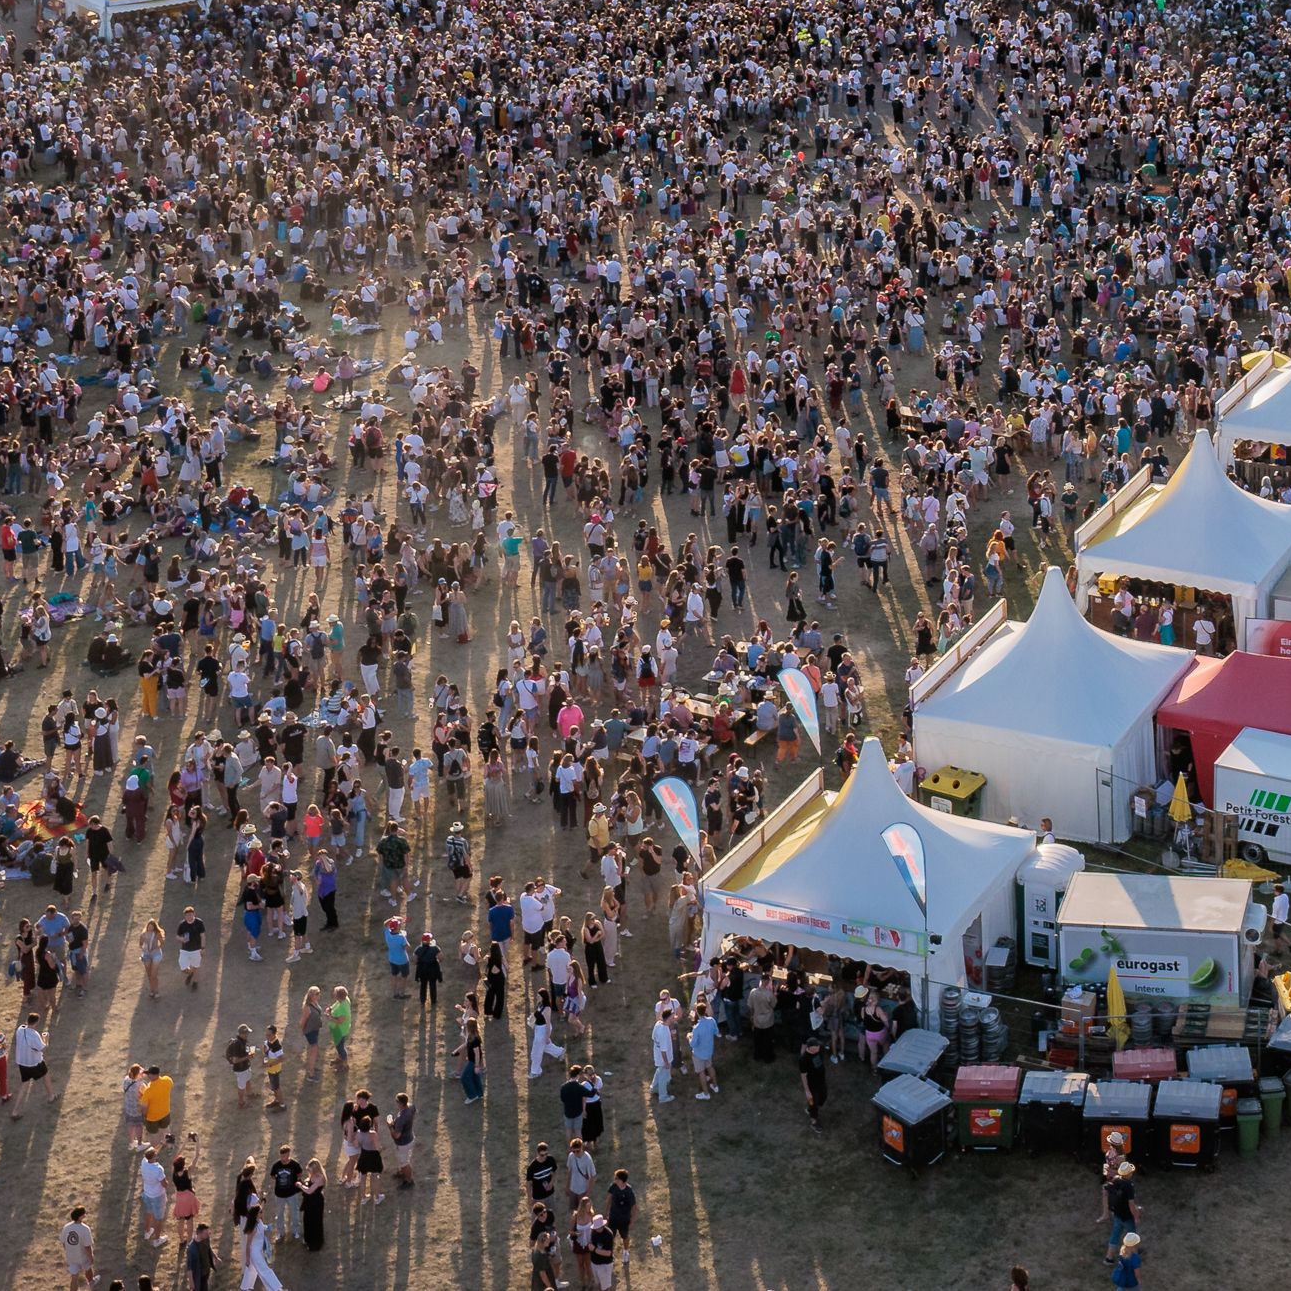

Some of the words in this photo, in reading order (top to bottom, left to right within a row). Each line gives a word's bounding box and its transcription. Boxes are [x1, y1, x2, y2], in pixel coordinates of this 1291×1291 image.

[1225, 802, 1253, 814] Petit
[731, 907, 748, 918] ICE
[765, 908, 778, 920] BEST
[797, 914, 810, 926] WITH
[810, 916, 831, 931] FRIENDS
[1116, 957, 1181, 973] eurogast
[1134, 984, 1166, 994] Interex
